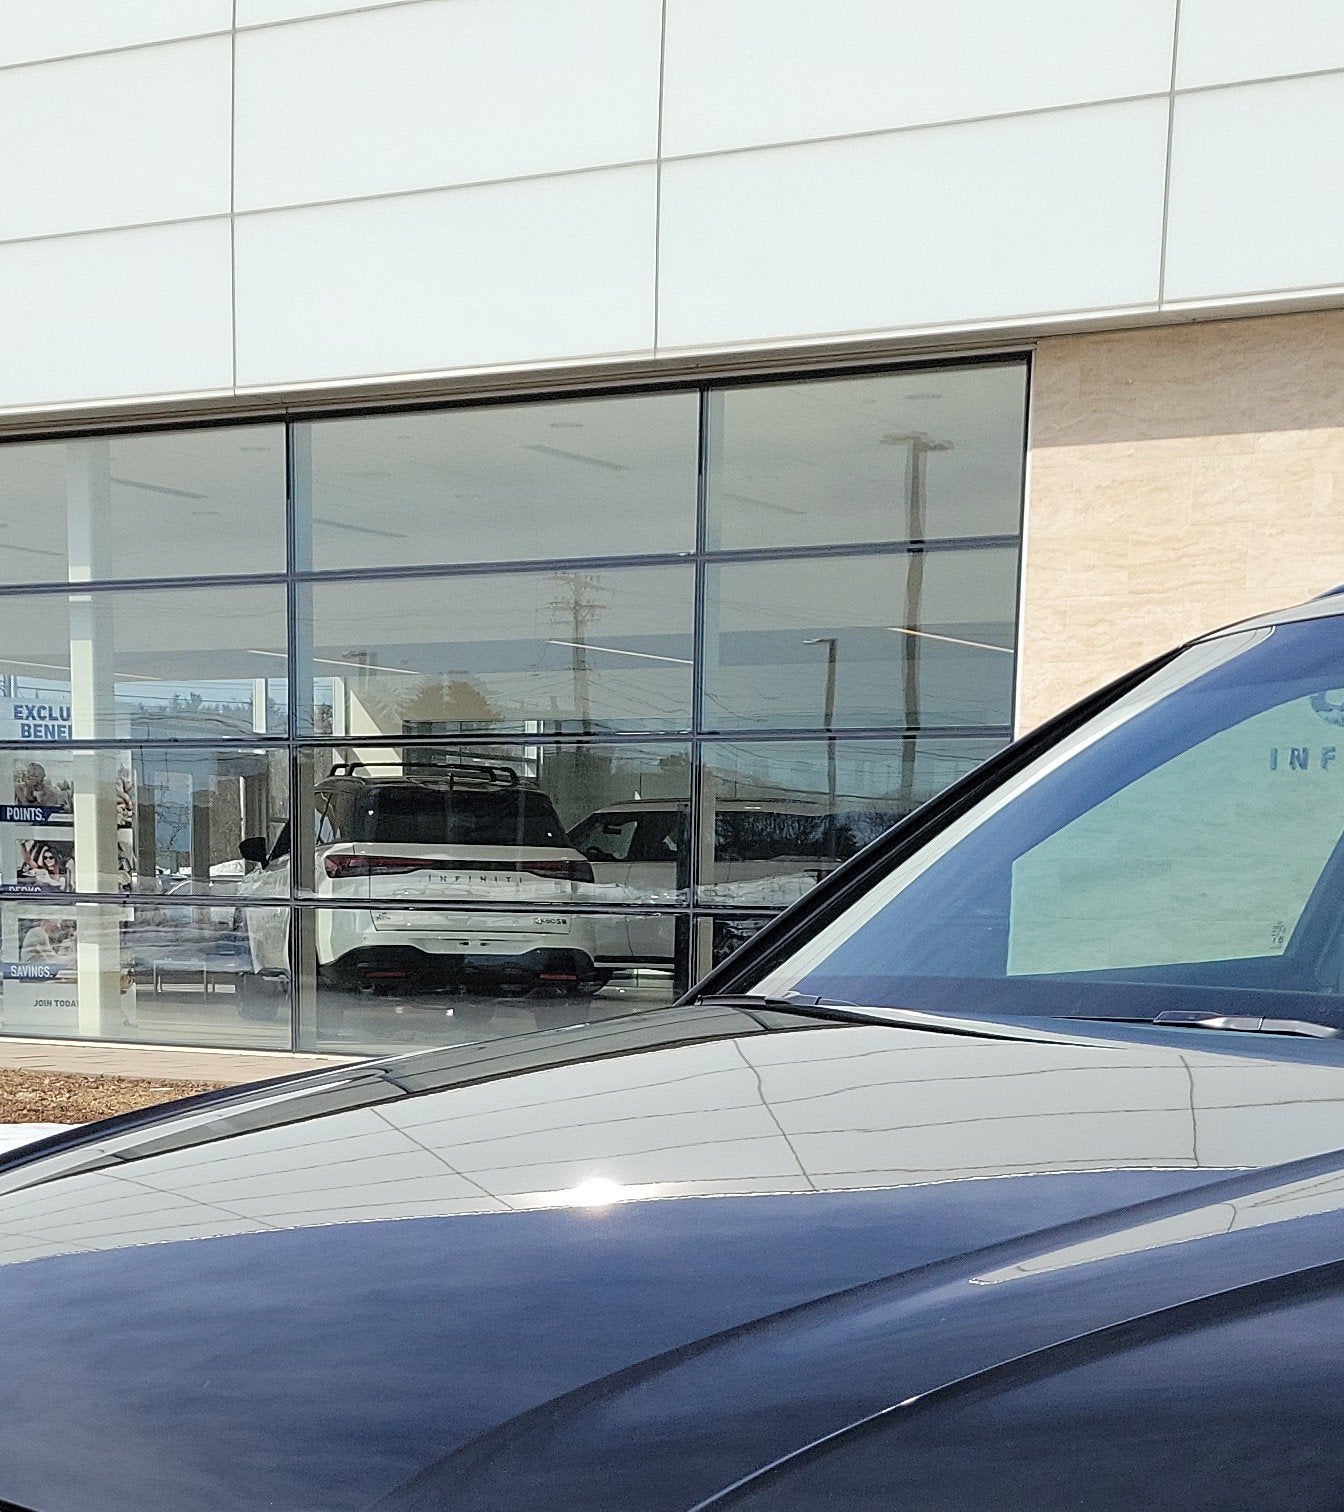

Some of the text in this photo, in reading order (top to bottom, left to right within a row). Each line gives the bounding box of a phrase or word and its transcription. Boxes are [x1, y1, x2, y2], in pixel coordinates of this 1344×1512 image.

[13, 704, 71, 721] EXCLU
[6, 807, 46, 821] POINTS.
[10, 965, 53, 978] SAVINGS.
[54, 1000, 79, 1008] TODA
